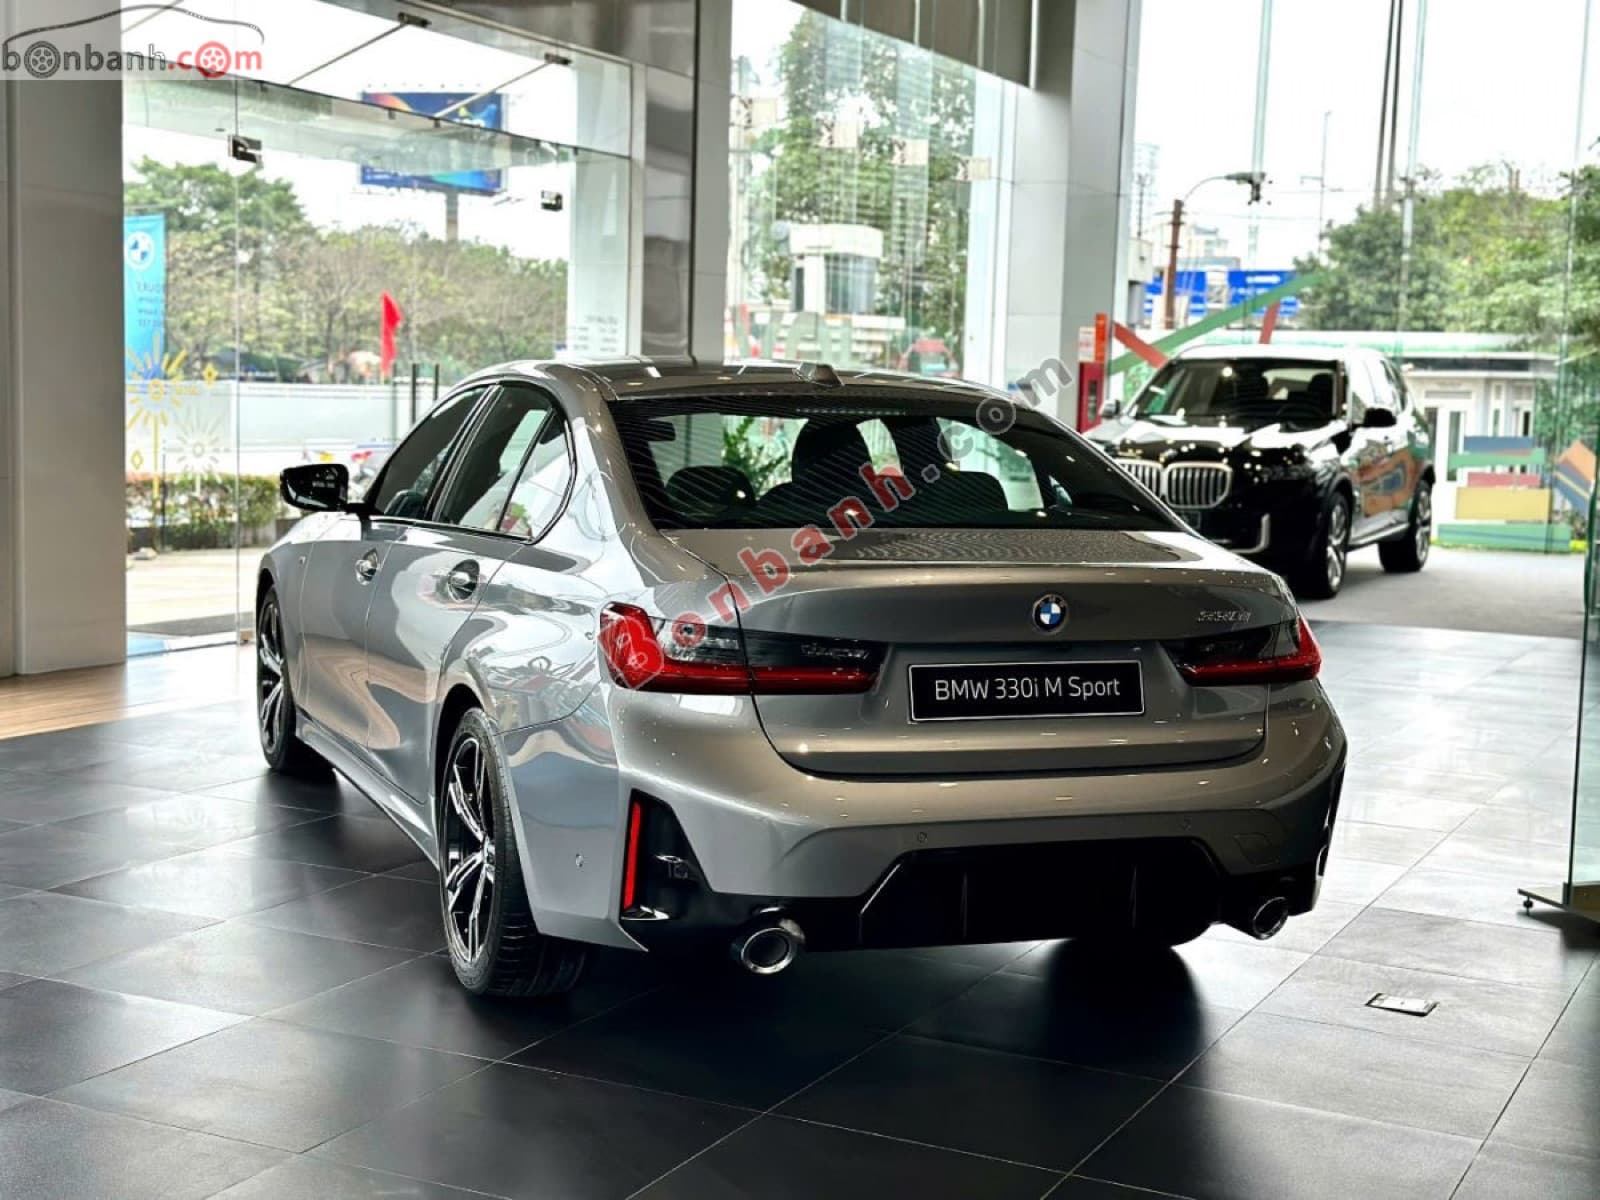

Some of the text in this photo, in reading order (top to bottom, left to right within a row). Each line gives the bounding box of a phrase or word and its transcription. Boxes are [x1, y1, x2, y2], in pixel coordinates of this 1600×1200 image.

[935, 676, 1120, 701] BMW 330i M Sport
